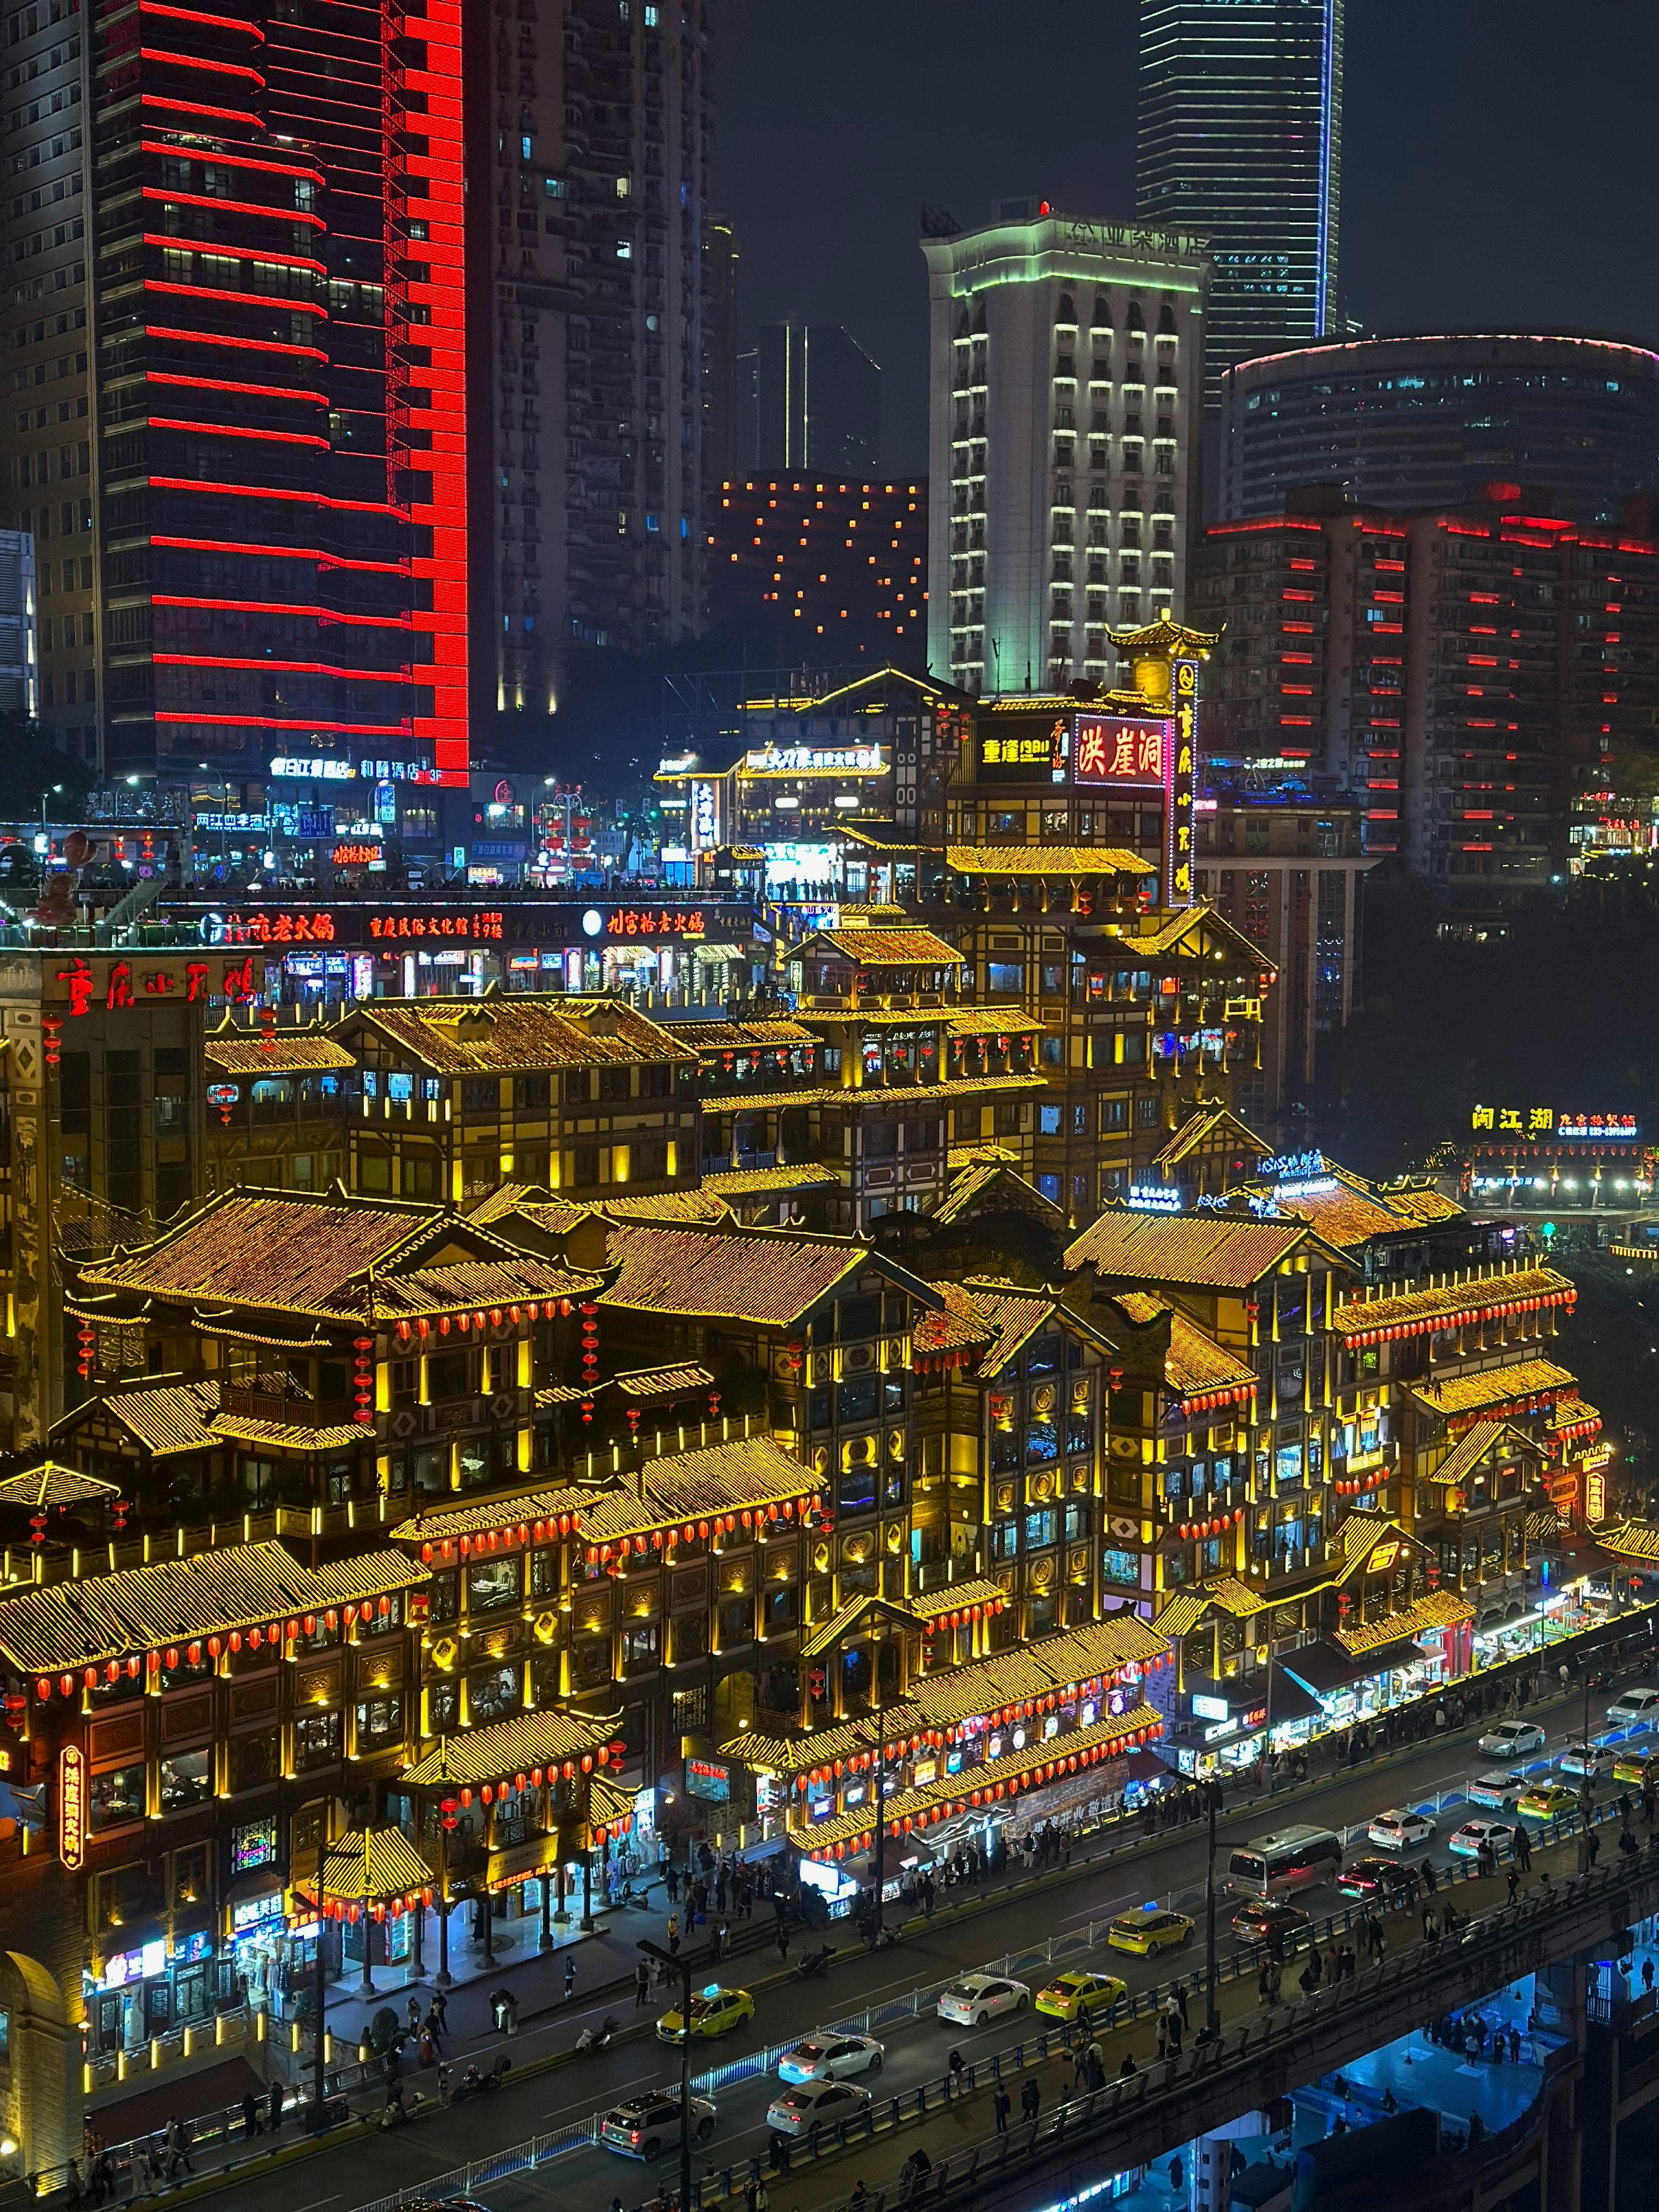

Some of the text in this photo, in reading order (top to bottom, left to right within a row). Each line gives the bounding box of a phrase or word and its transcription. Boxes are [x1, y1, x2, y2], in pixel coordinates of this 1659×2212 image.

[1079, 724, 1163, 779] 洪崖洞
[370, 916, 469, 938] 重庆民俗文化馆
